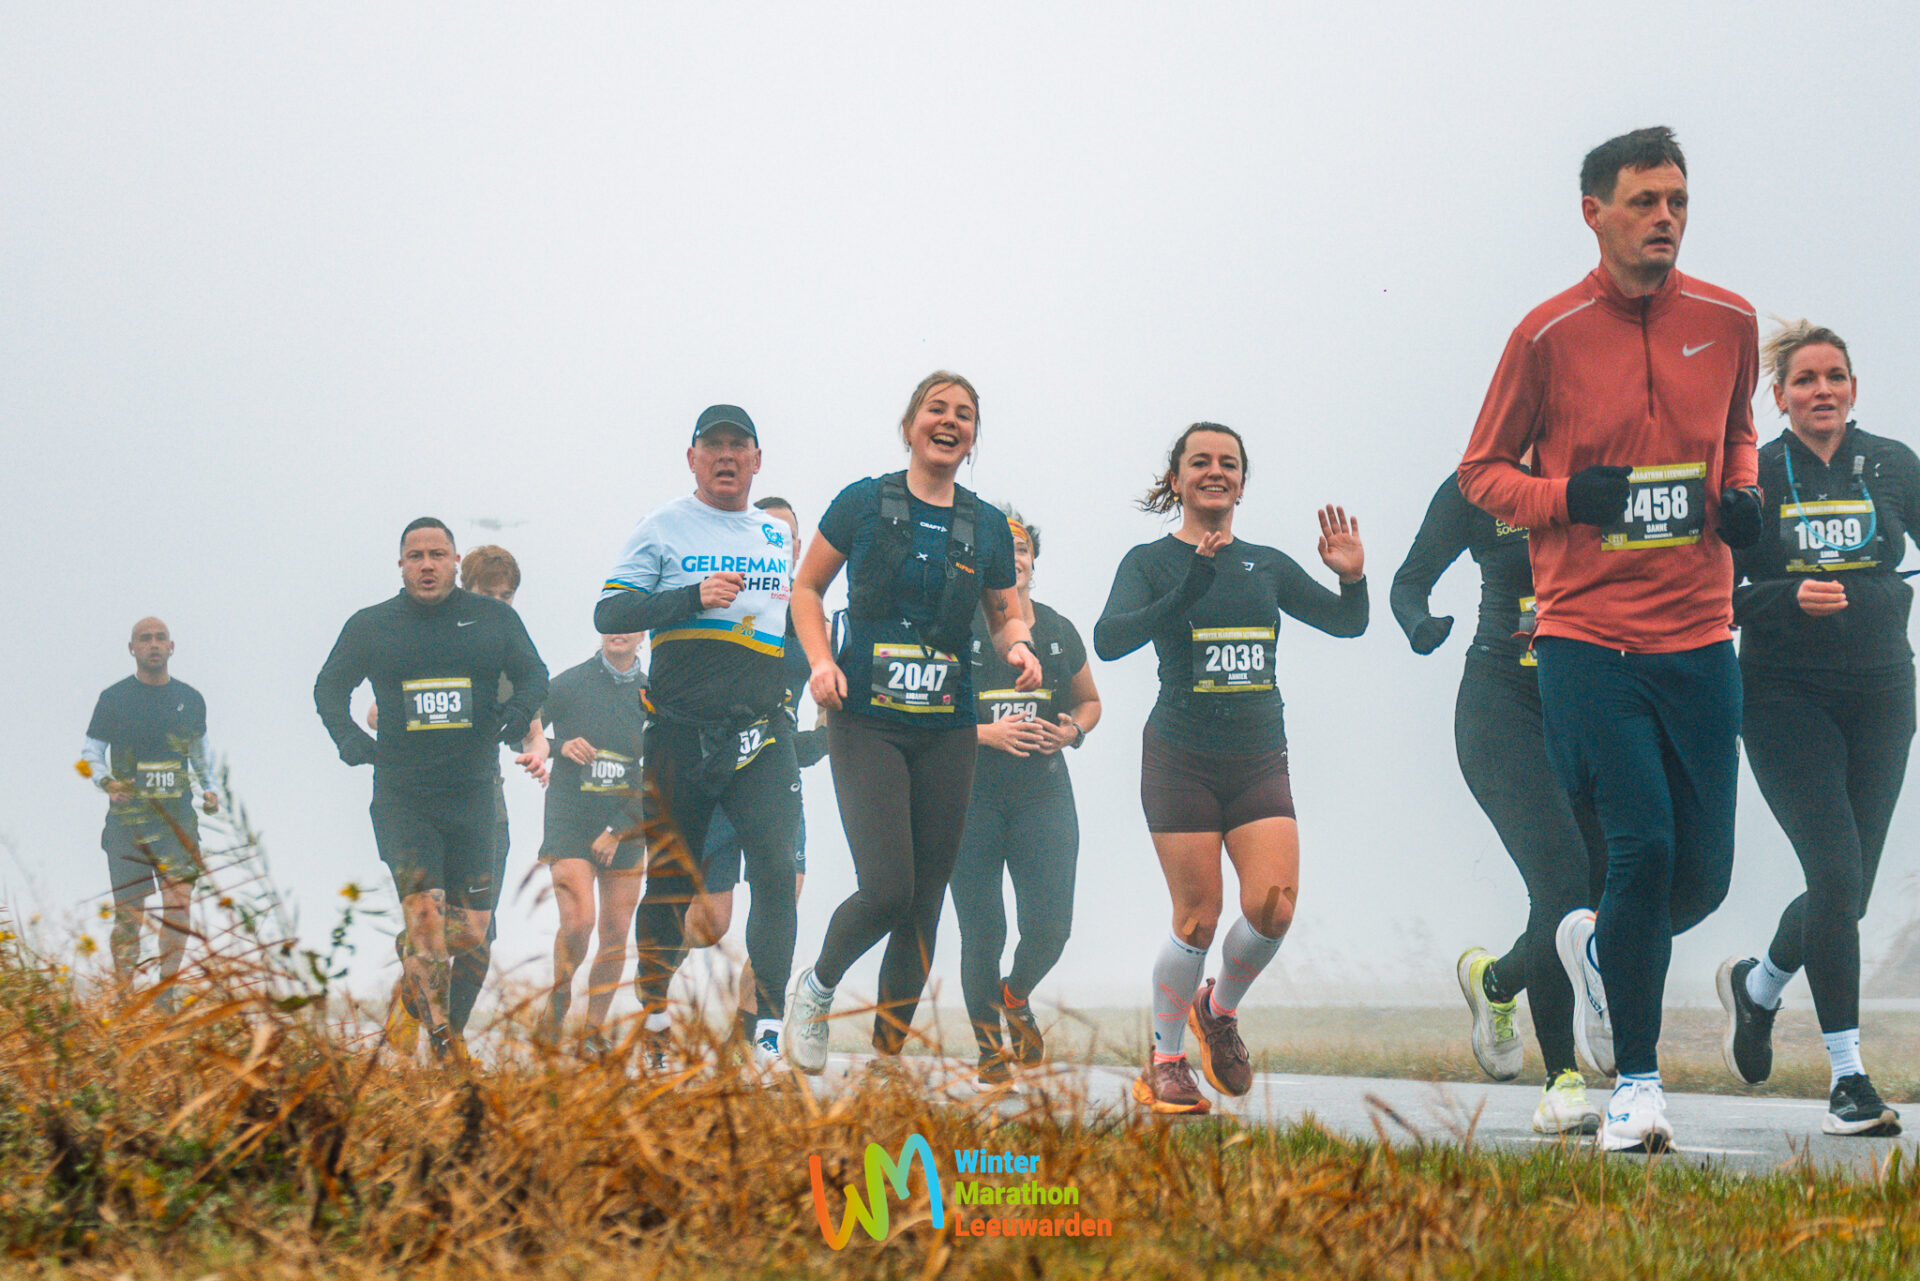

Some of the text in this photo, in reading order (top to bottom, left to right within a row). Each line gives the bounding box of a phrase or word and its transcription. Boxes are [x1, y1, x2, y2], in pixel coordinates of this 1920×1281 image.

[1624, 485, 1688, 523] 1458
[1794, 518, 1862, 550] 1089
[681, 555, 787, 574] GELREMAN
[1206, 644, 1265, 672] 2038
[888, 661, 948, 691] 2047
[413, 691, 461, 714] 1693
[991, 701, 1037, 724] 1259
[146, 771, 175, 787] 2119
